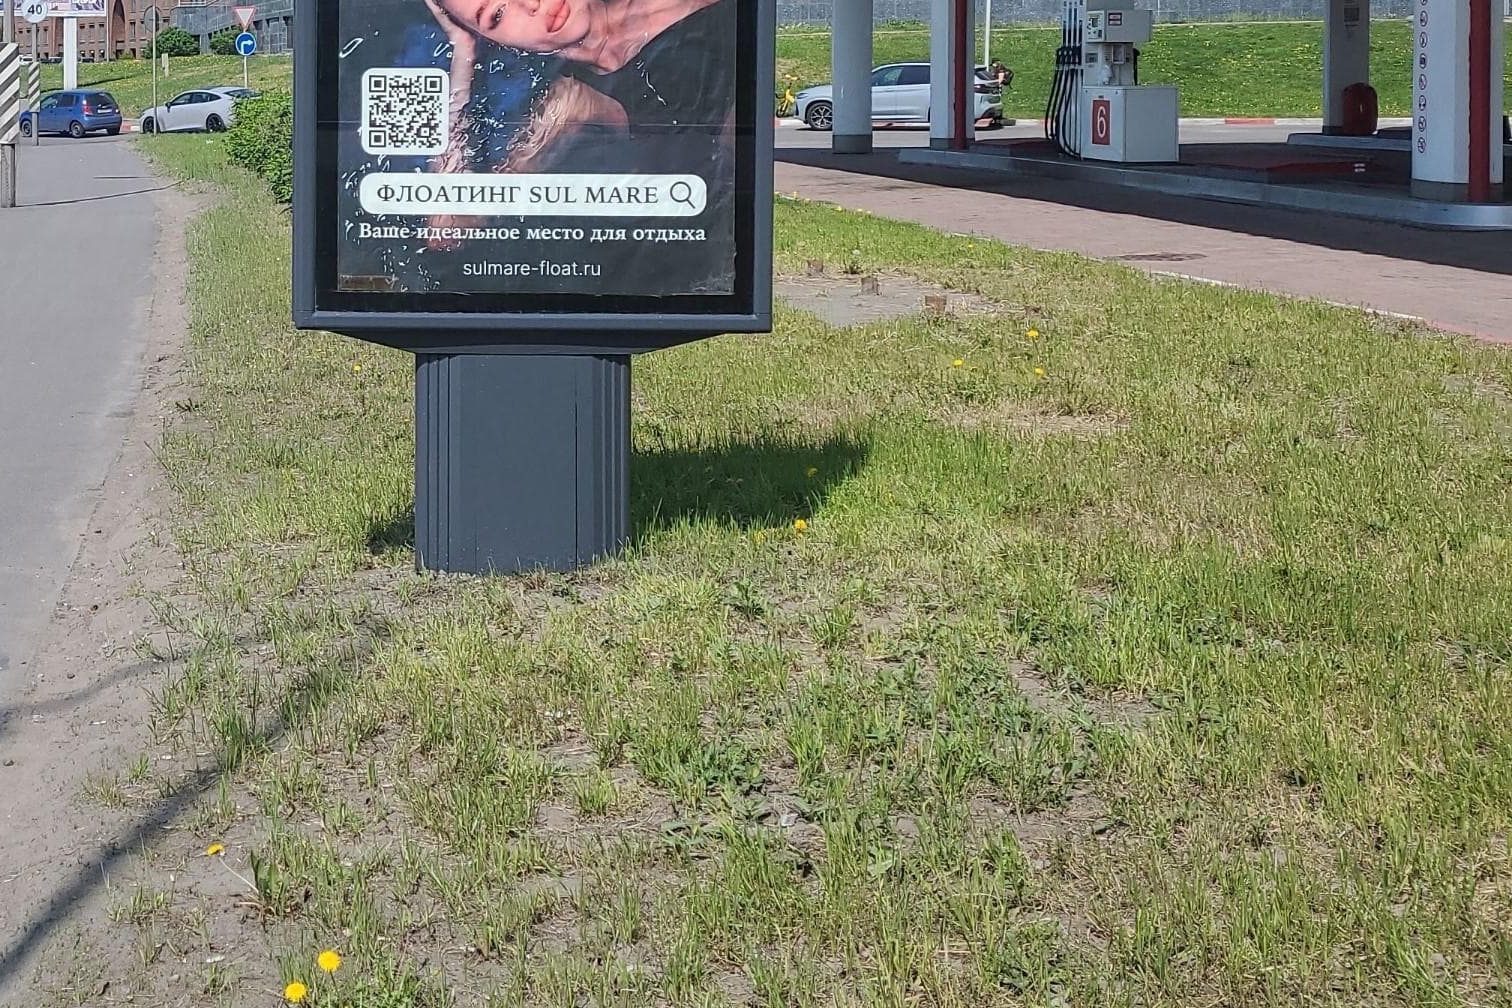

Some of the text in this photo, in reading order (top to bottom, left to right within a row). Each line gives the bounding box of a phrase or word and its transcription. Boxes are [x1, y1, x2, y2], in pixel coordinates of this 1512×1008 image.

[27, 4, 43, 14] 40
[1097, 105, 1107, 138] 6
[377, 184, 659, 204] ФЛОАТИНГ SUL MARE
[359, 222, 707, 243] Ваше идеальное место для отдыха
[463, 260, 601, 276] sulmare-float.ru
